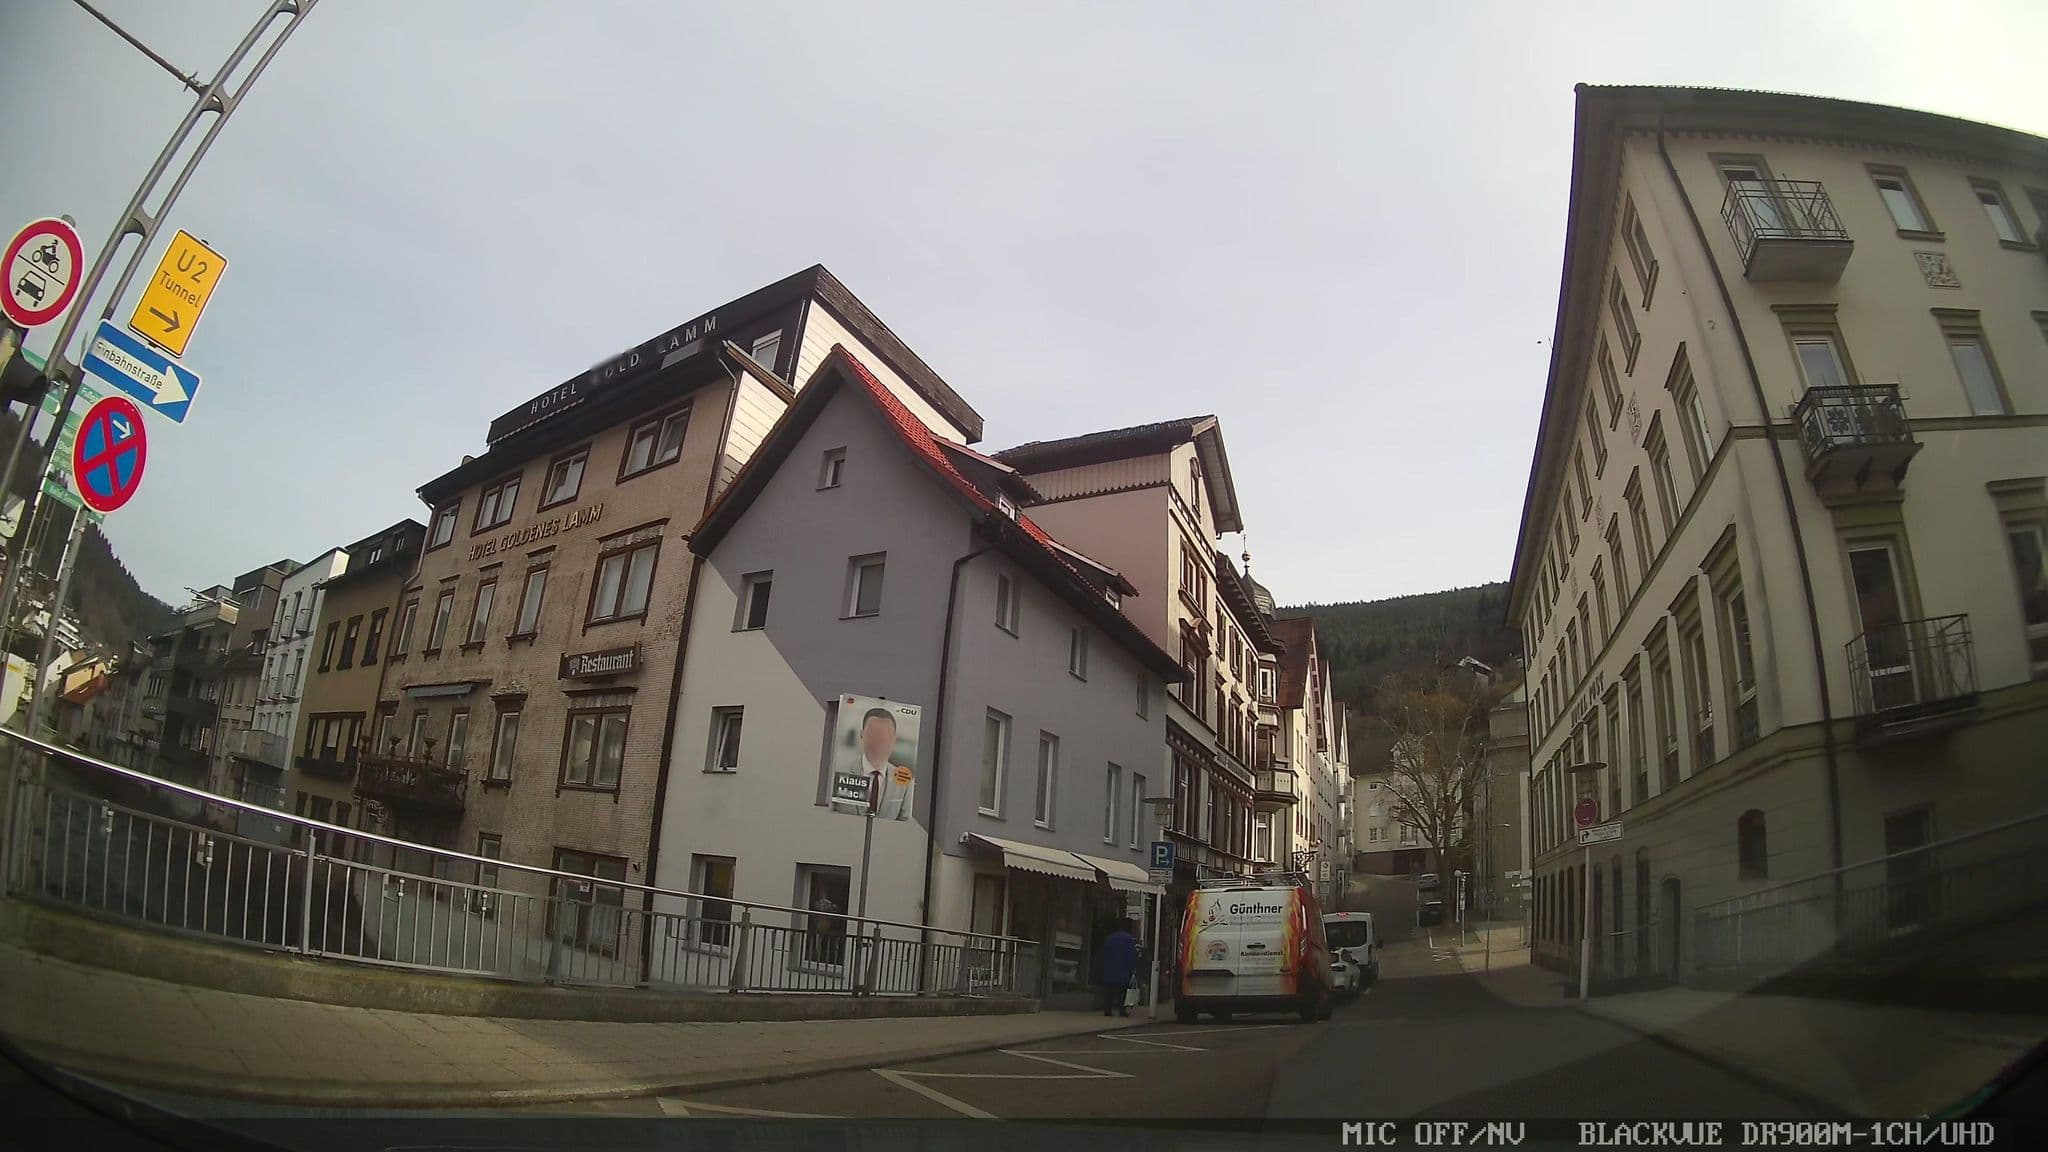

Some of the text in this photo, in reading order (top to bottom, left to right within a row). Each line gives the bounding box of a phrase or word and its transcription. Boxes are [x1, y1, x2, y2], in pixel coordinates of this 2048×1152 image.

[177, 248, 208, 284] U2
[160, 270, 202, 308] Tunnel
[530, 382, 577, 415] HOTEL
[590, 353, 640, 385] OLD
[468, 503, 604, 561] HOTEL GOLDENES LAMM
[580, 649, 634, 674] Restaurant
[900, 707, 918, 717] CDU
[839, 776, 868, 788] Klaus
[1156, 845, 1168, 865] P
[1230, 902, 1283, 915] Günthner
